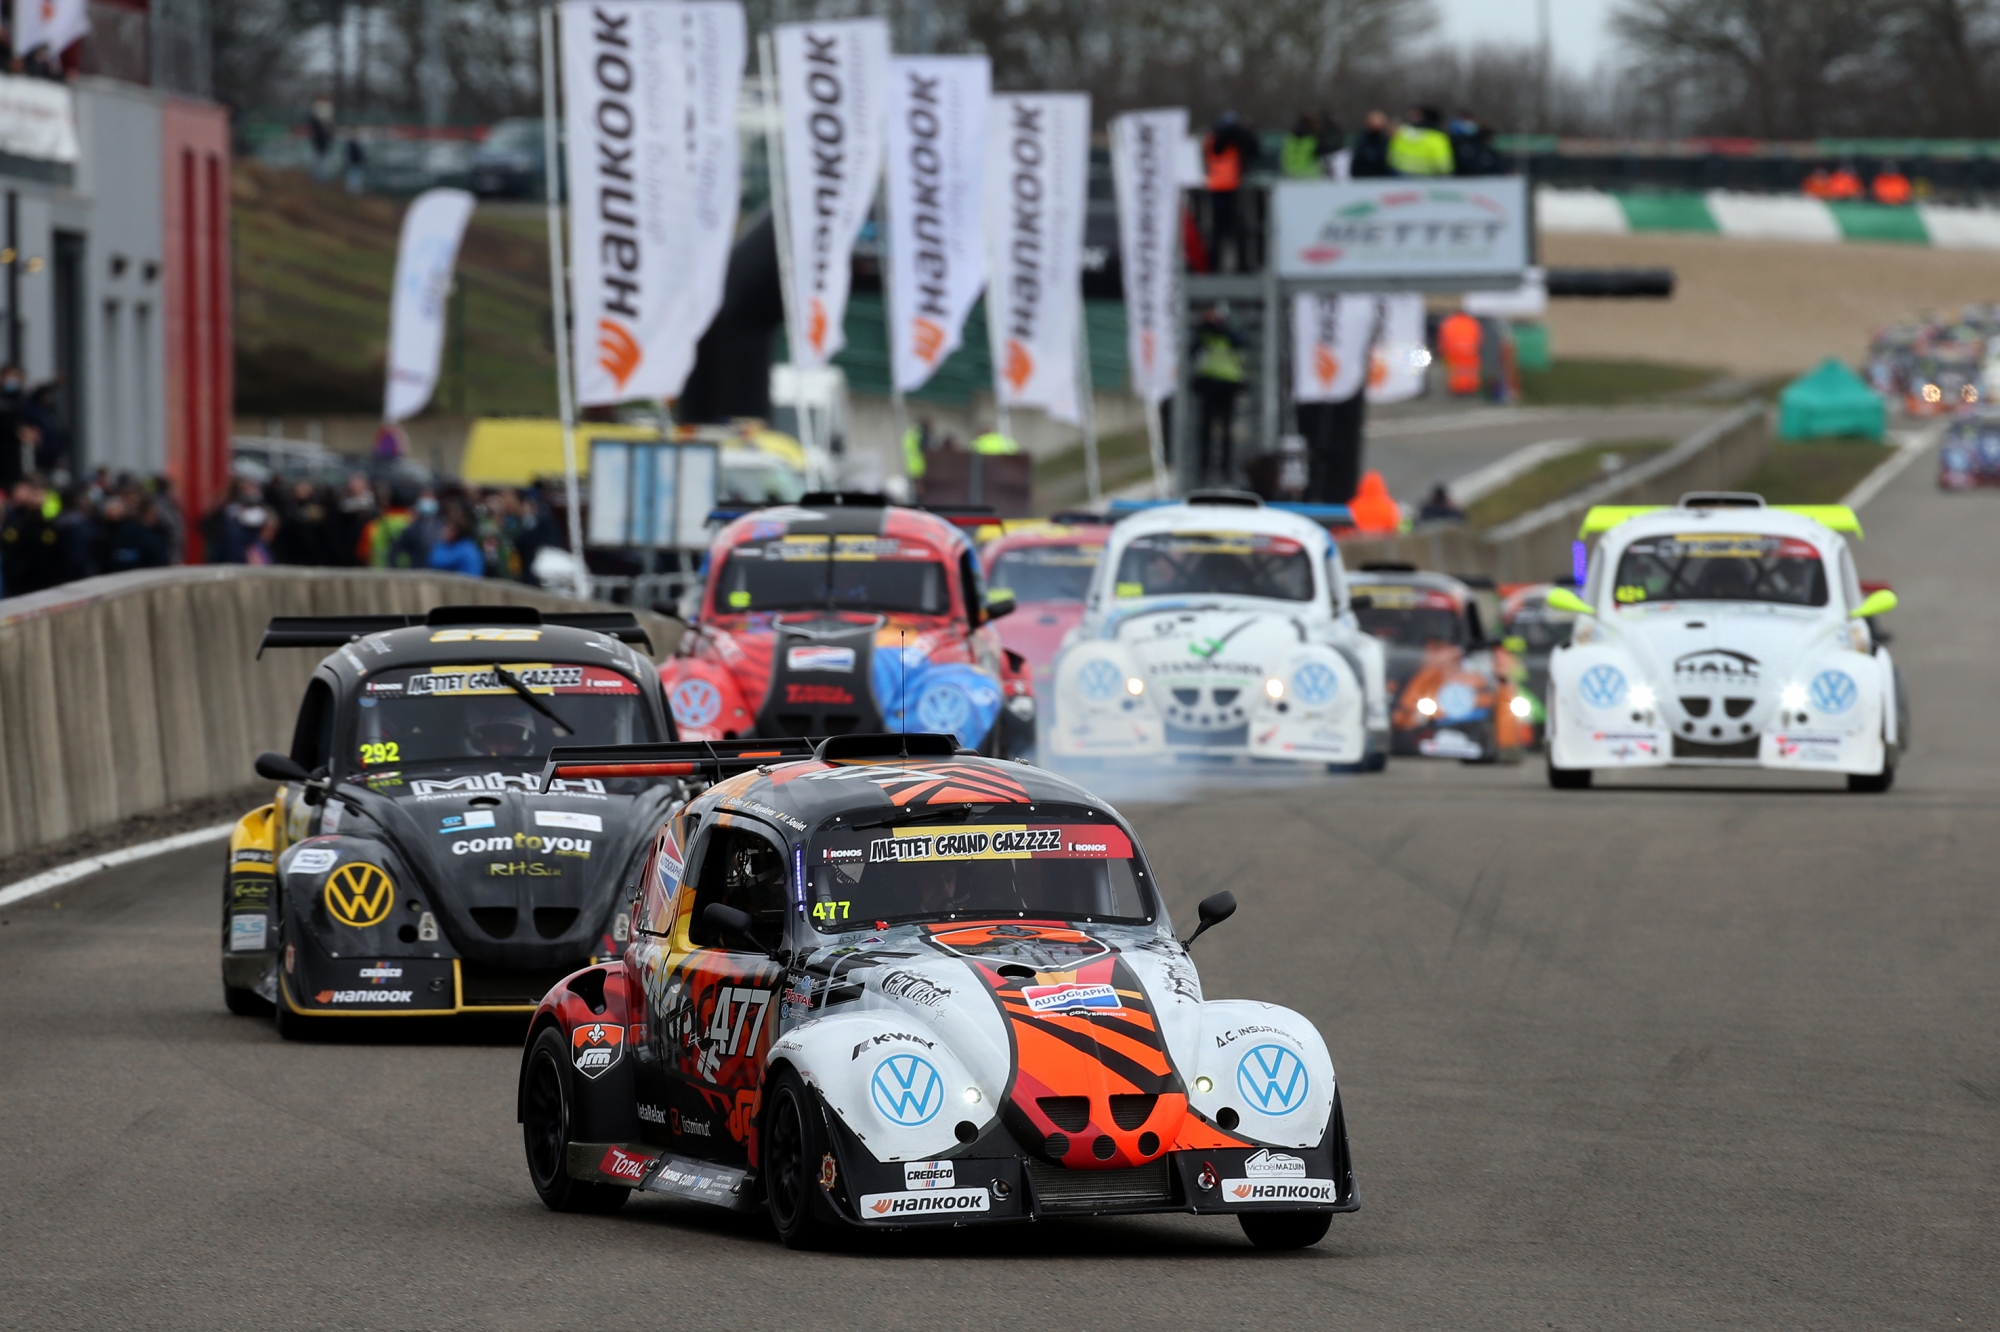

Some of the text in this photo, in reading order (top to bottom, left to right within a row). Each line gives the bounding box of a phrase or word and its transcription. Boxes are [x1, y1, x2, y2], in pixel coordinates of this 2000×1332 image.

[407, 675, 466, 695] METTET
[360, 742, 400, 764] 292
[869, 828, 1062, 863] METTET GRAND GAZZZZ
[811, 901, 851, 921] 477
[1033, 986, 1114, 1008] AUTOGRAPHE
[710, 986, 772, 1057] 477
[1033, 1011, 1068, 1019] VEHICLE
[1215, 1030, 1238, 1048] A.C.
[907, 1169, 953, 1181] CREDECO
